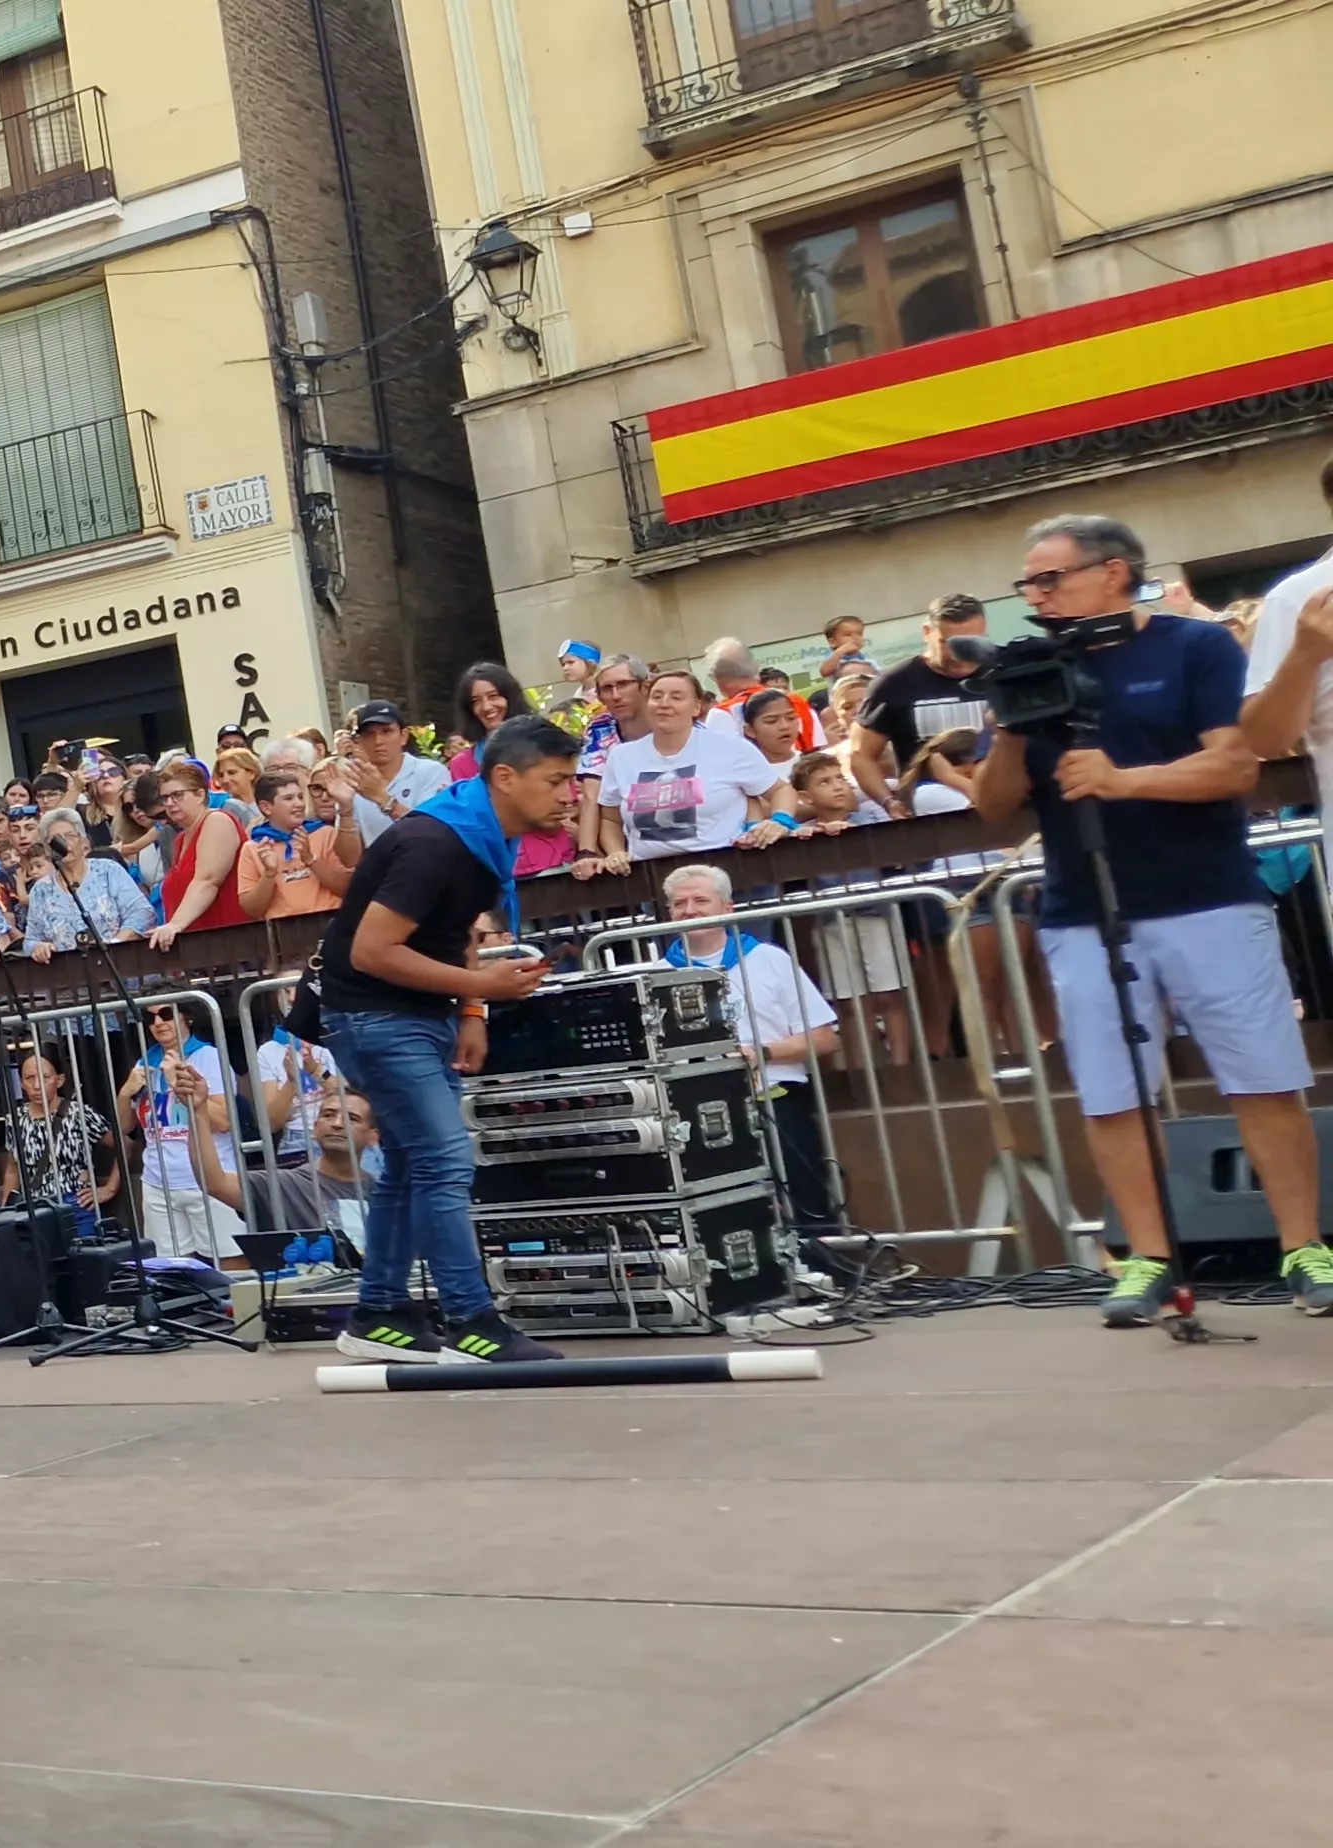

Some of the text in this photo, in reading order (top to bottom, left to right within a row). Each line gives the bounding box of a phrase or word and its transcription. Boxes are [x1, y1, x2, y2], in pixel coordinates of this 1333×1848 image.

[216, 483, 261, 507] CALLE
[201, 503, 264, 532] MAYOR
[34, 586, 242, 649] Ciudadana
